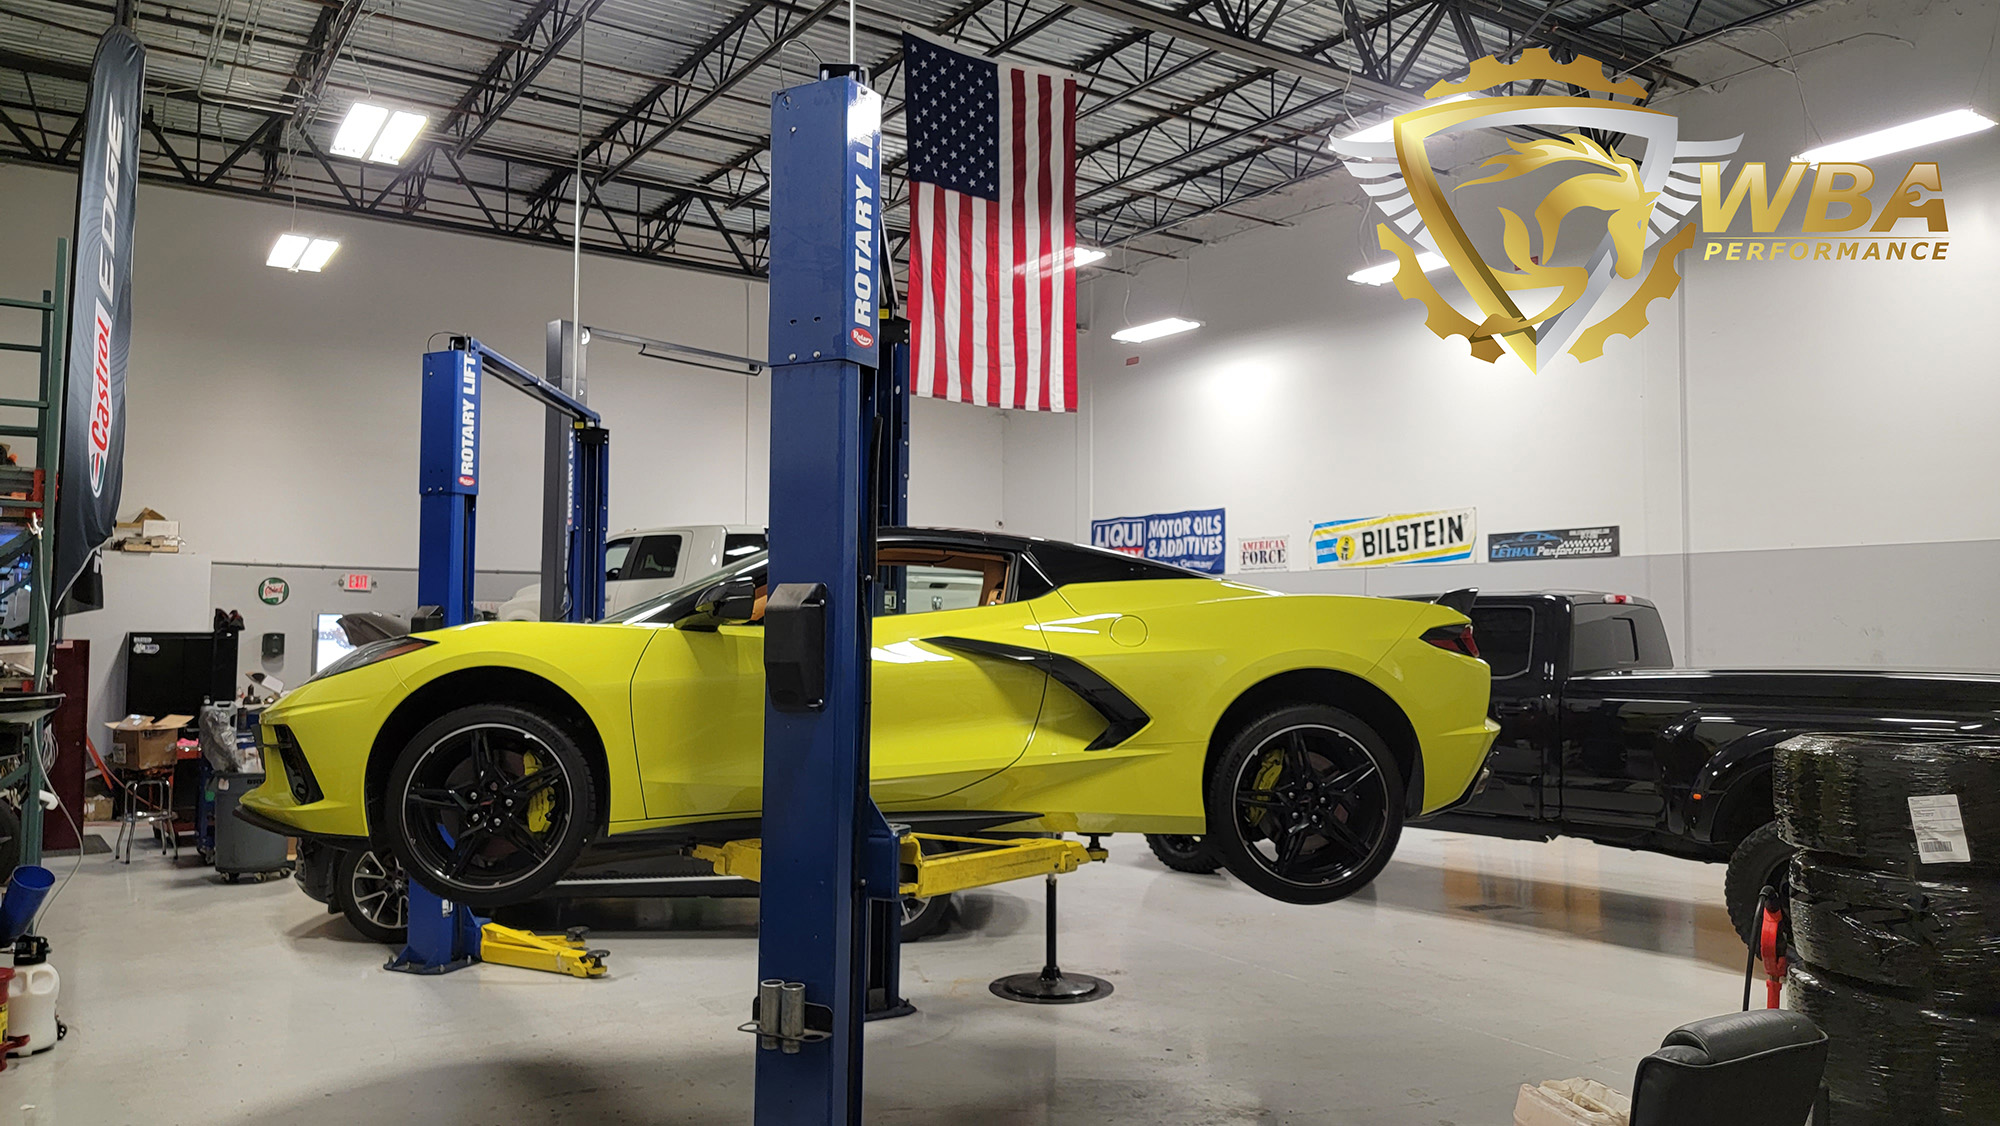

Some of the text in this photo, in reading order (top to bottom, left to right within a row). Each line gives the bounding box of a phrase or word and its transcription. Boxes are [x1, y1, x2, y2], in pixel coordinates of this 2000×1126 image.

[854, 174, 873, 327] ROTARY
[92, 92, 124, 452] Castrol EDGE
[463, 353, 476, 395] LIFT
[461, 397, 475, 476] ROTARY
[1094, 522, 1143, 548] LIQUI
[1147, 515, 1222, 539] MOTOR OILS
[1362, 514, 1464, 558] BILSTEIN
[1147, 539, 1158, 558] &
[1158, 535, 1223, 558] ADDITIVES
[1242, 548, 1286, 565] FORCE
[1243, 540, 1286, 551] AMERICAN
[1491, 545, 1612, 558] LETHAL Performance
[349, 574, 368, 589] EXIT
